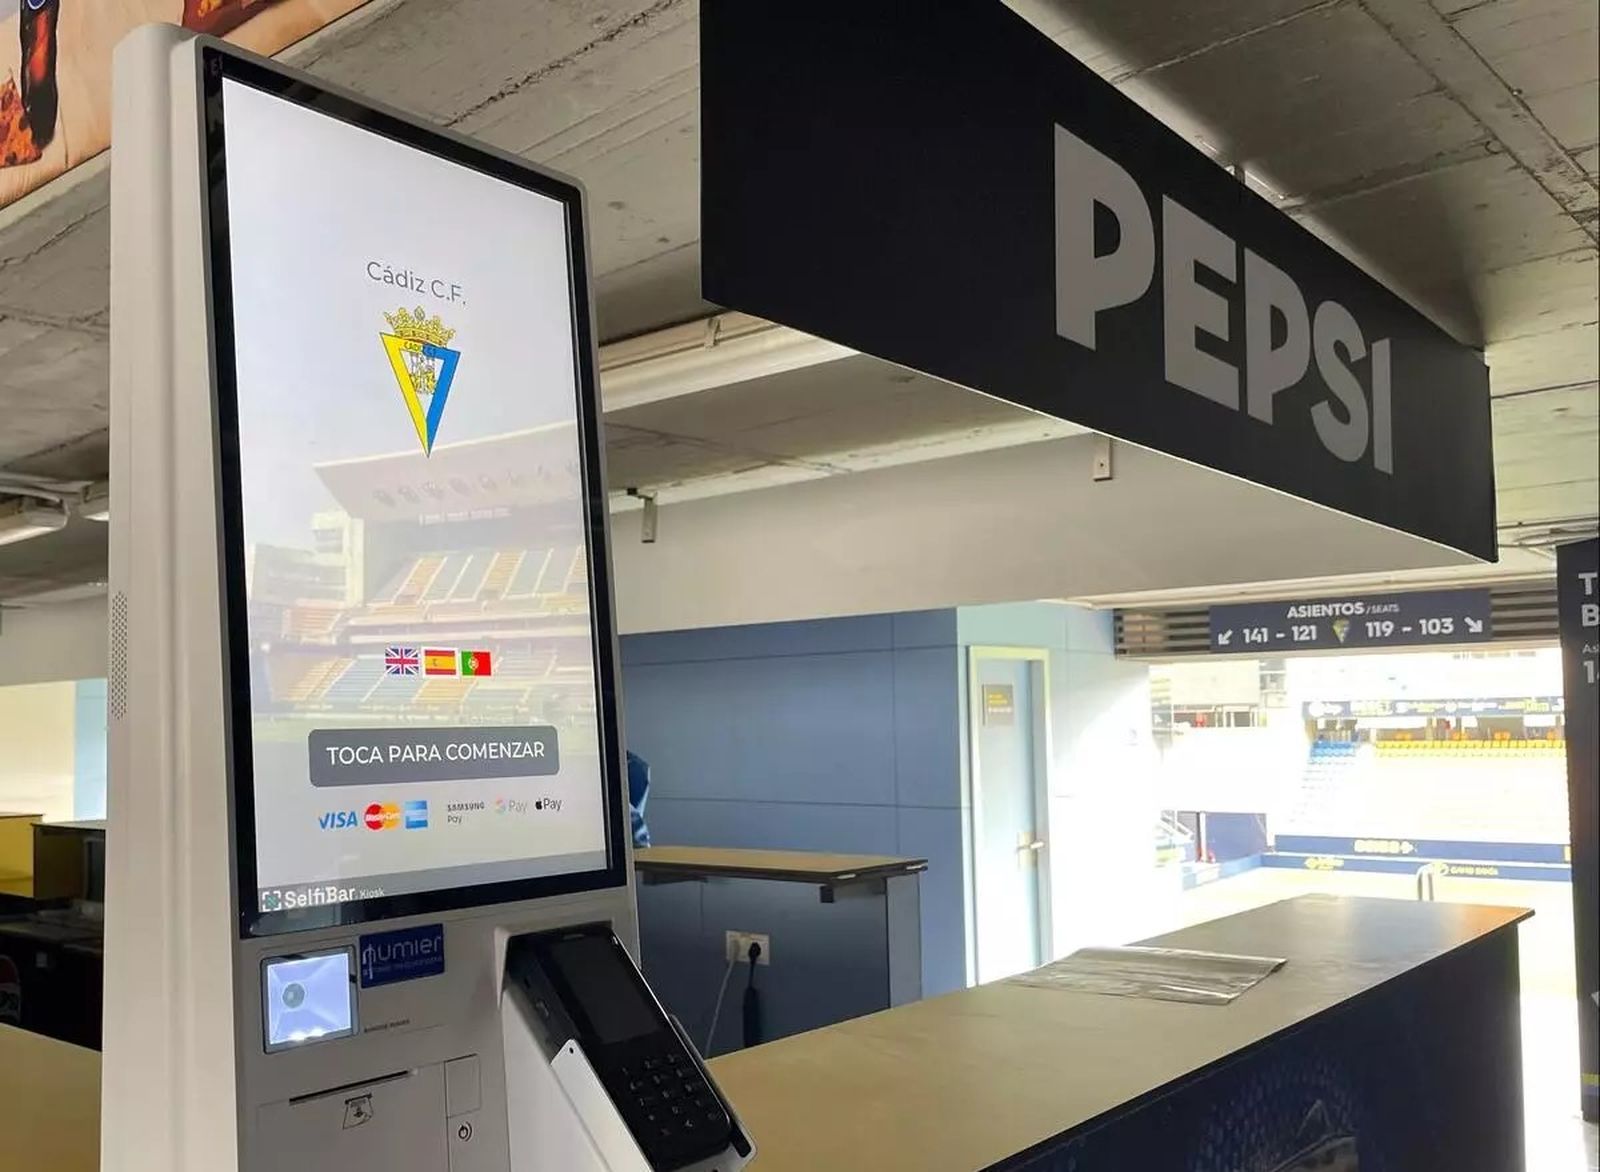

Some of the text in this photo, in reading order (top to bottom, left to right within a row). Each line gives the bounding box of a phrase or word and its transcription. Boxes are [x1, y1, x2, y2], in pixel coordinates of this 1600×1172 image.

[367, 261, 466, 305] Cádiz C.F.
[1054, 122, 1393, 475] PEPSI
[1287, 602, 1364, 619] ASIENTOS
[1243, 627, 1268, 643] 141
[1292, 625, 1317, 641] 121
[1366, 621, 1394, 637] 119
[1419, 618, 1454, 635] 103
[326, 741, 545, 766] TOCA PARA COMENZAR
[447, 801, 485, 812] SAMSUNG
[543, 798, 562, 812] Pay
[318, 811, 358, 829] VISA
[447, 815, 462, 824] Pay
[285, 885, 355, 908] SelfiBar
